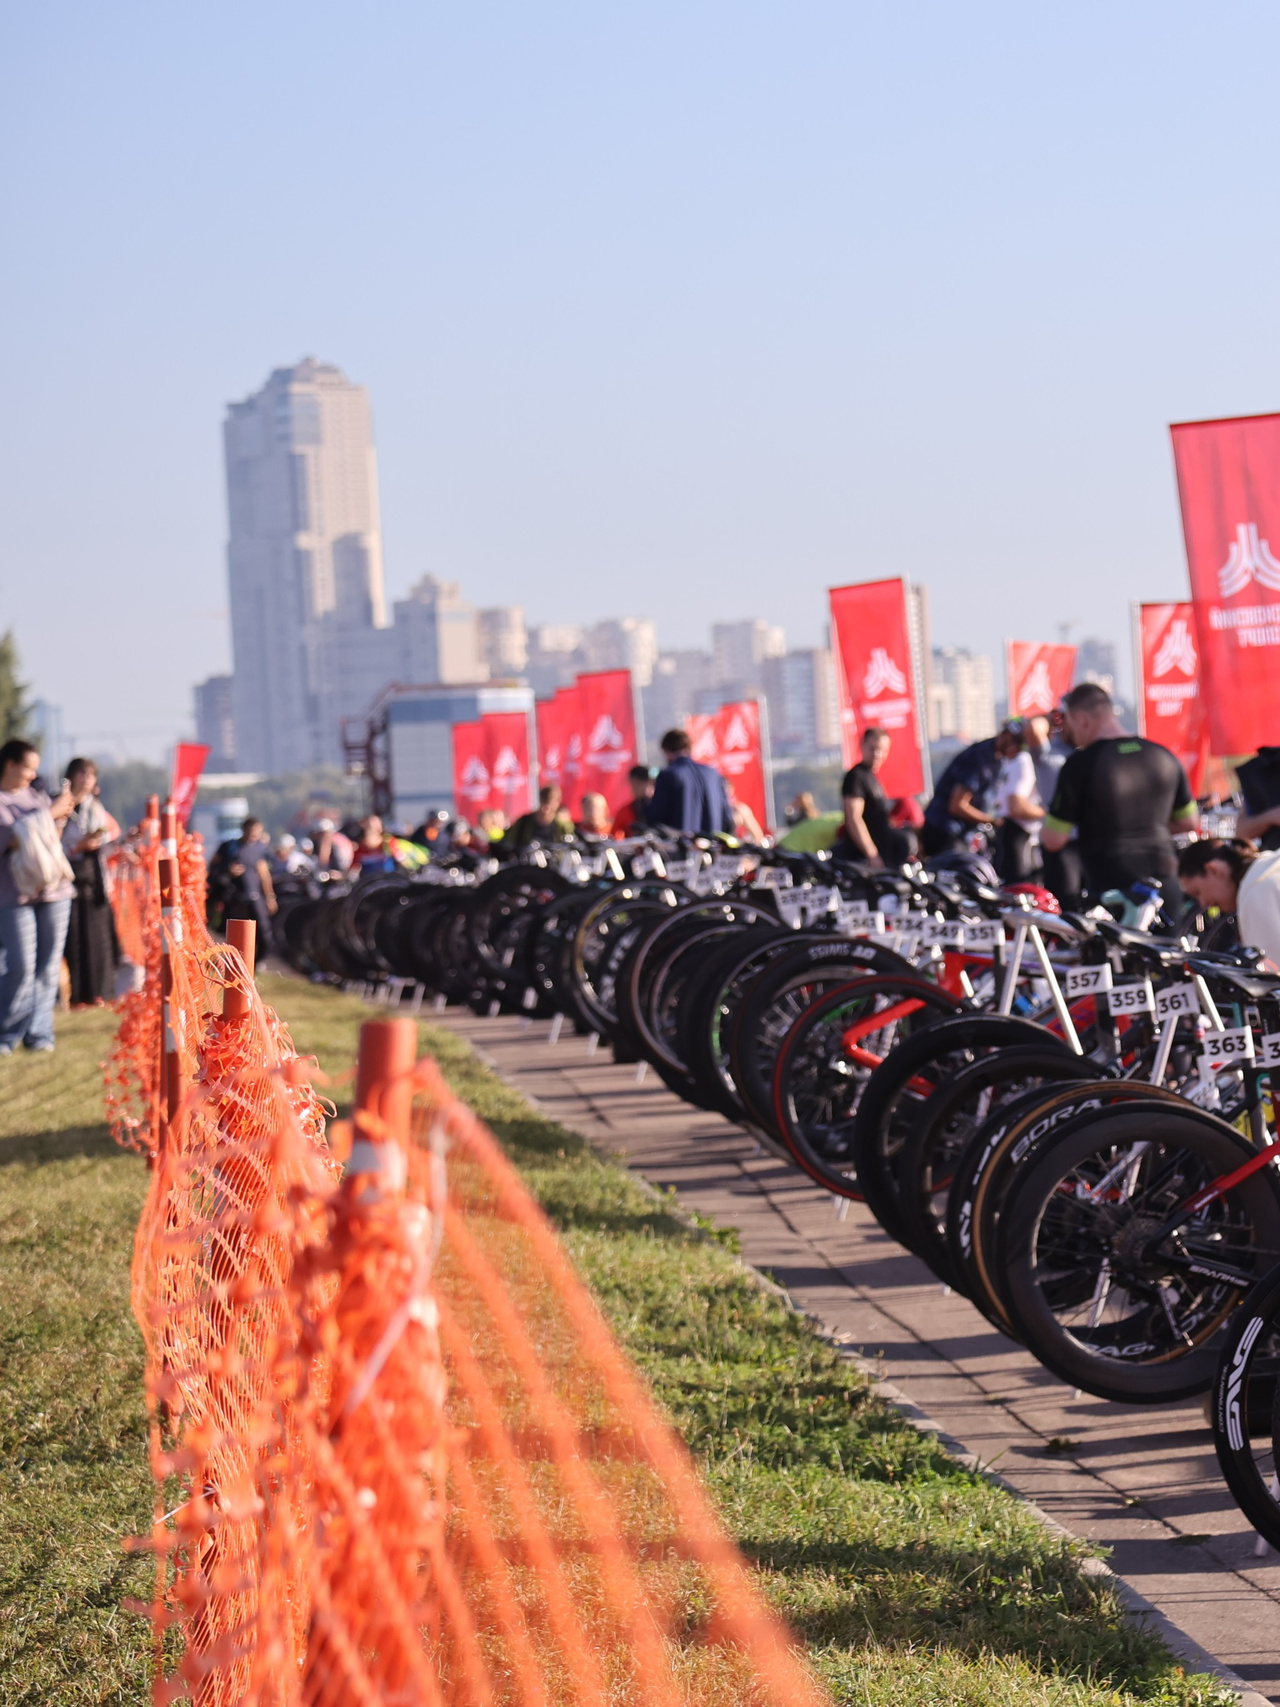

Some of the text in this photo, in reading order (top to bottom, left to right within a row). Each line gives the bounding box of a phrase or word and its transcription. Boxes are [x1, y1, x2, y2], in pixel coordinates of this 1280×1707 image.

[1069, 971, 1100, 989] 357
[1111, 990, 1146, 1008] 359
[1158, 993, 1190, 1014] 361
[1207, 1035, 1246, 1055] 363
[1010, 1098, 1103, 1164] BORA
